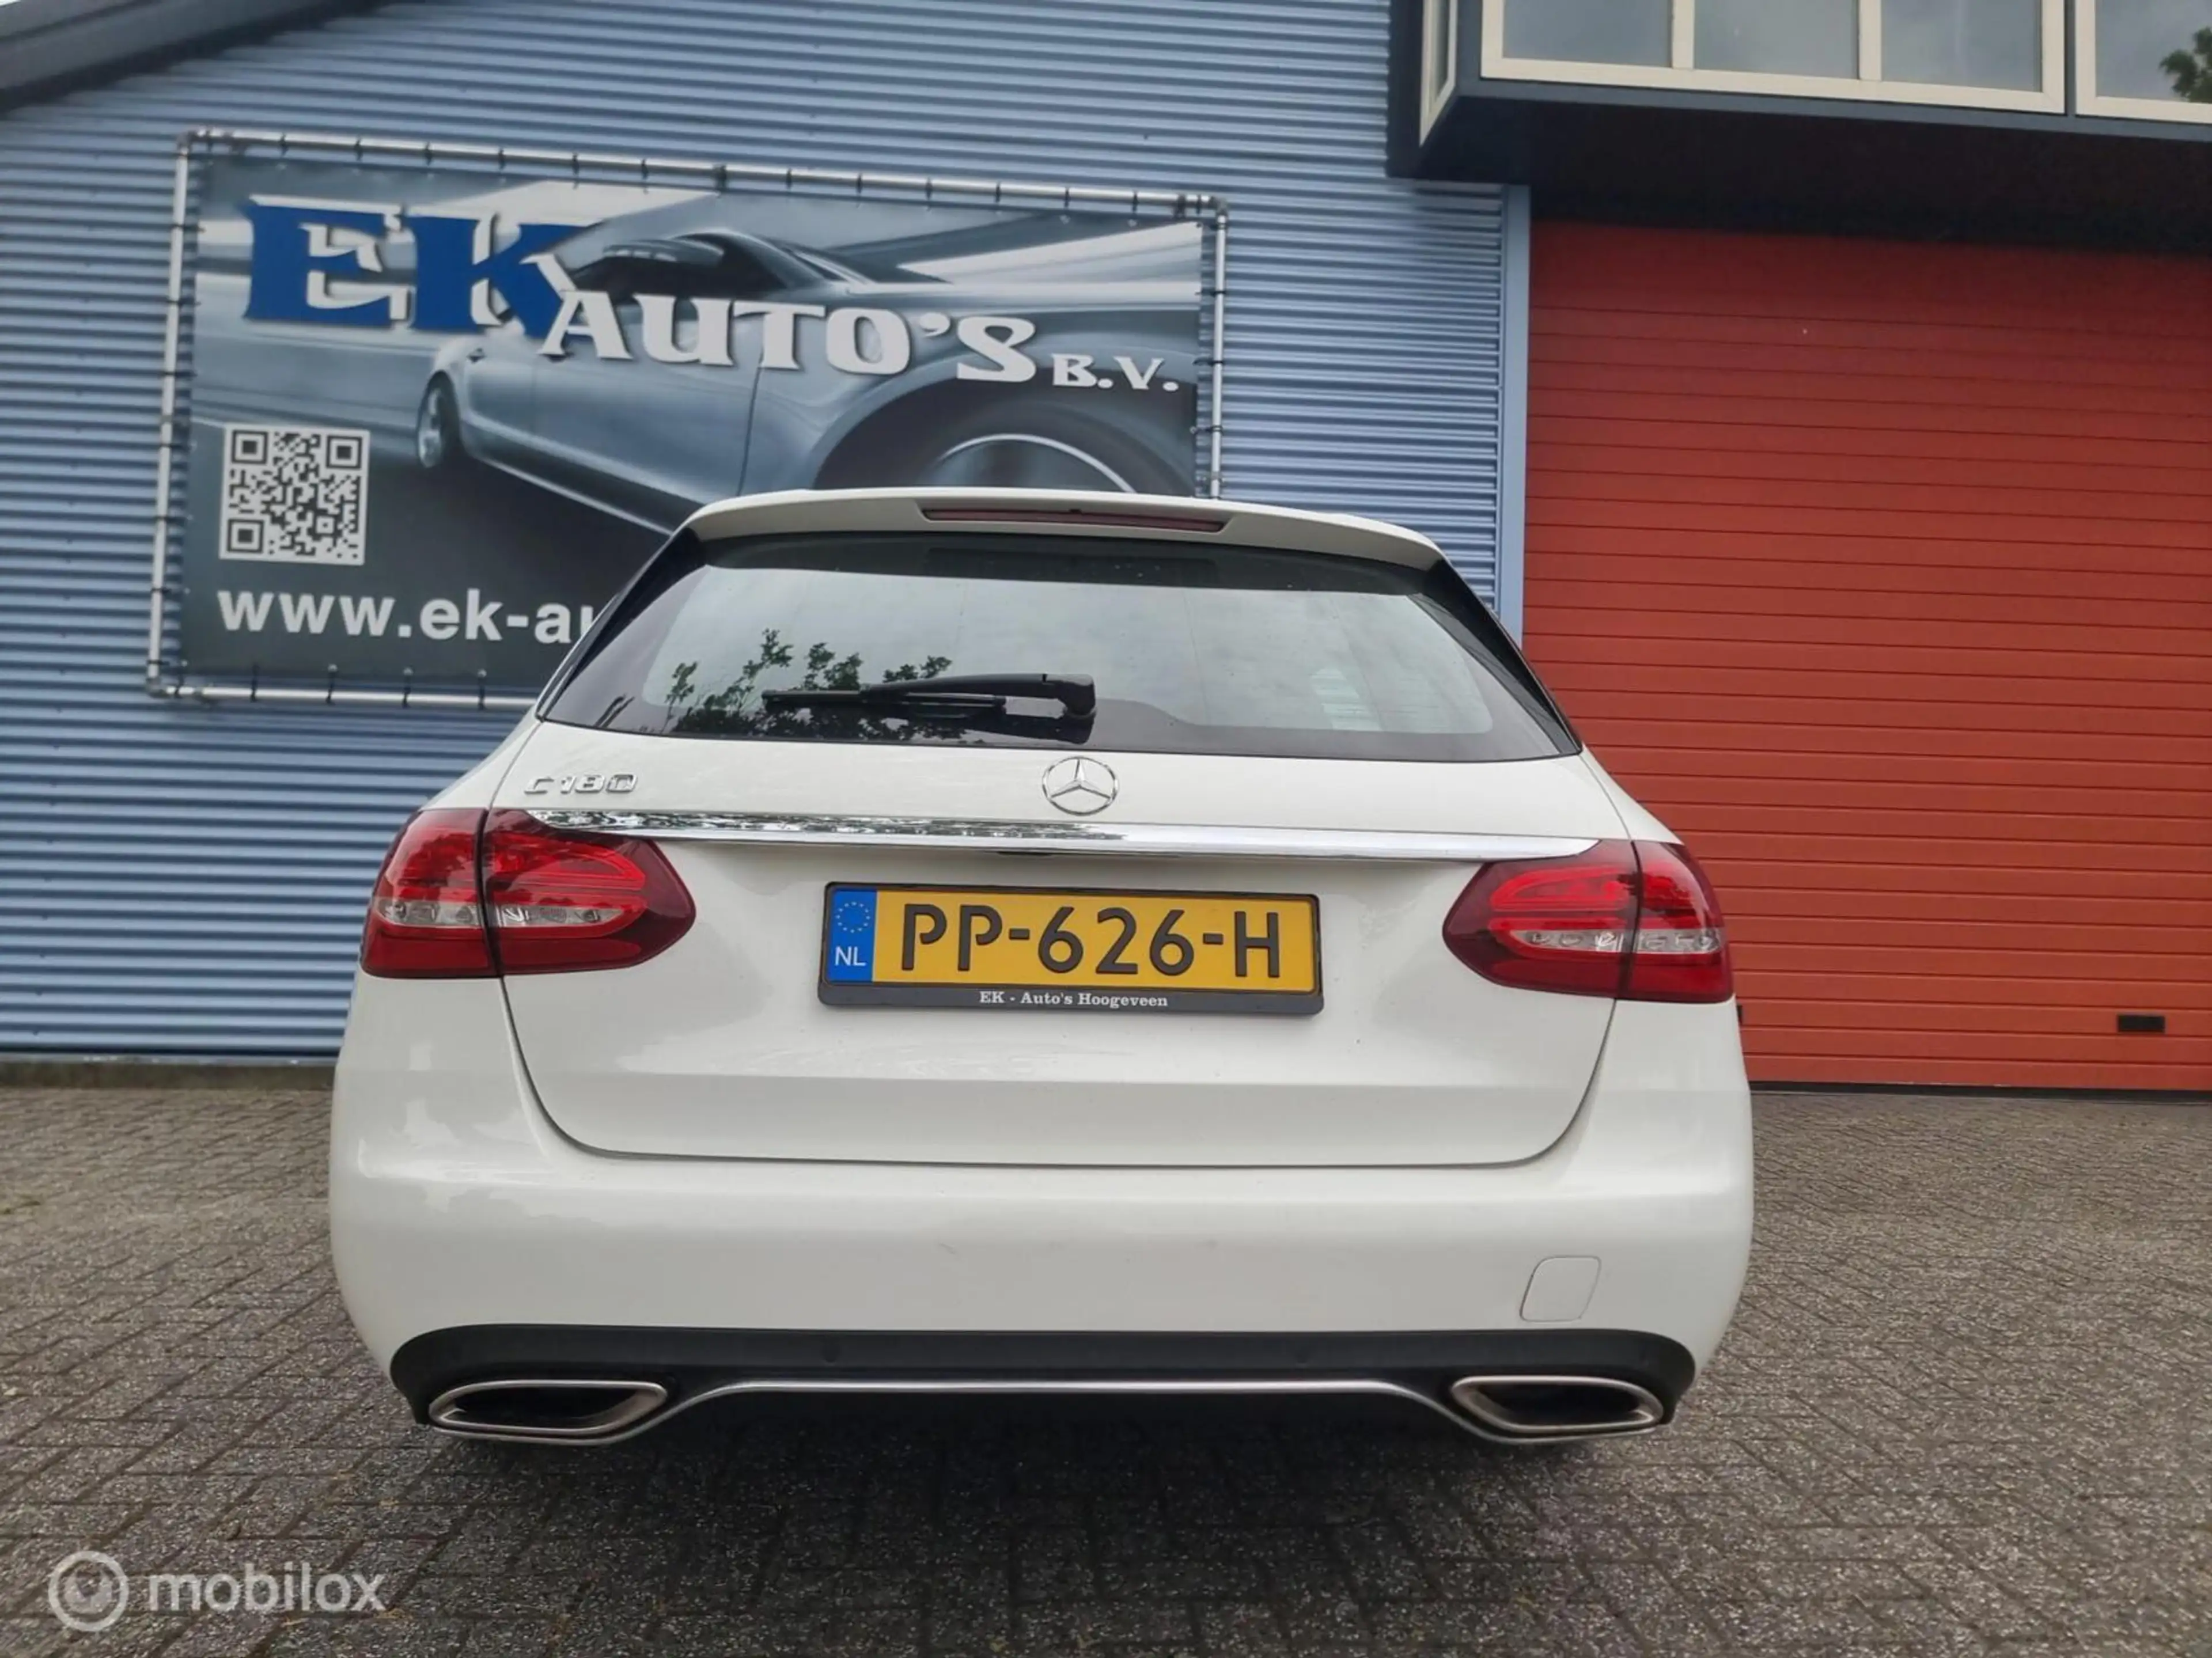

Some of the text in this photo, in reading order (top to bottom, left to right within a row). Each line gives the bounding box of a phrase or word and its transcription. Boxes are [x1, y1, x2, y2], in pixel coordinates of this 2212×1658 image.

[243, 196, 606, 339] EK
[1052, 352, 1179, 390] B.V.
[524, 774, 638, 794] C180
[901, 904, 1281, 978] PP-626-H
[835, 946, 867, 966] NL
[980, 991, 1005, 1004] EK
[1020, 992, 1073, 1005] Auto's
[1078, 993, 1168, 1008] Hoogeveen
